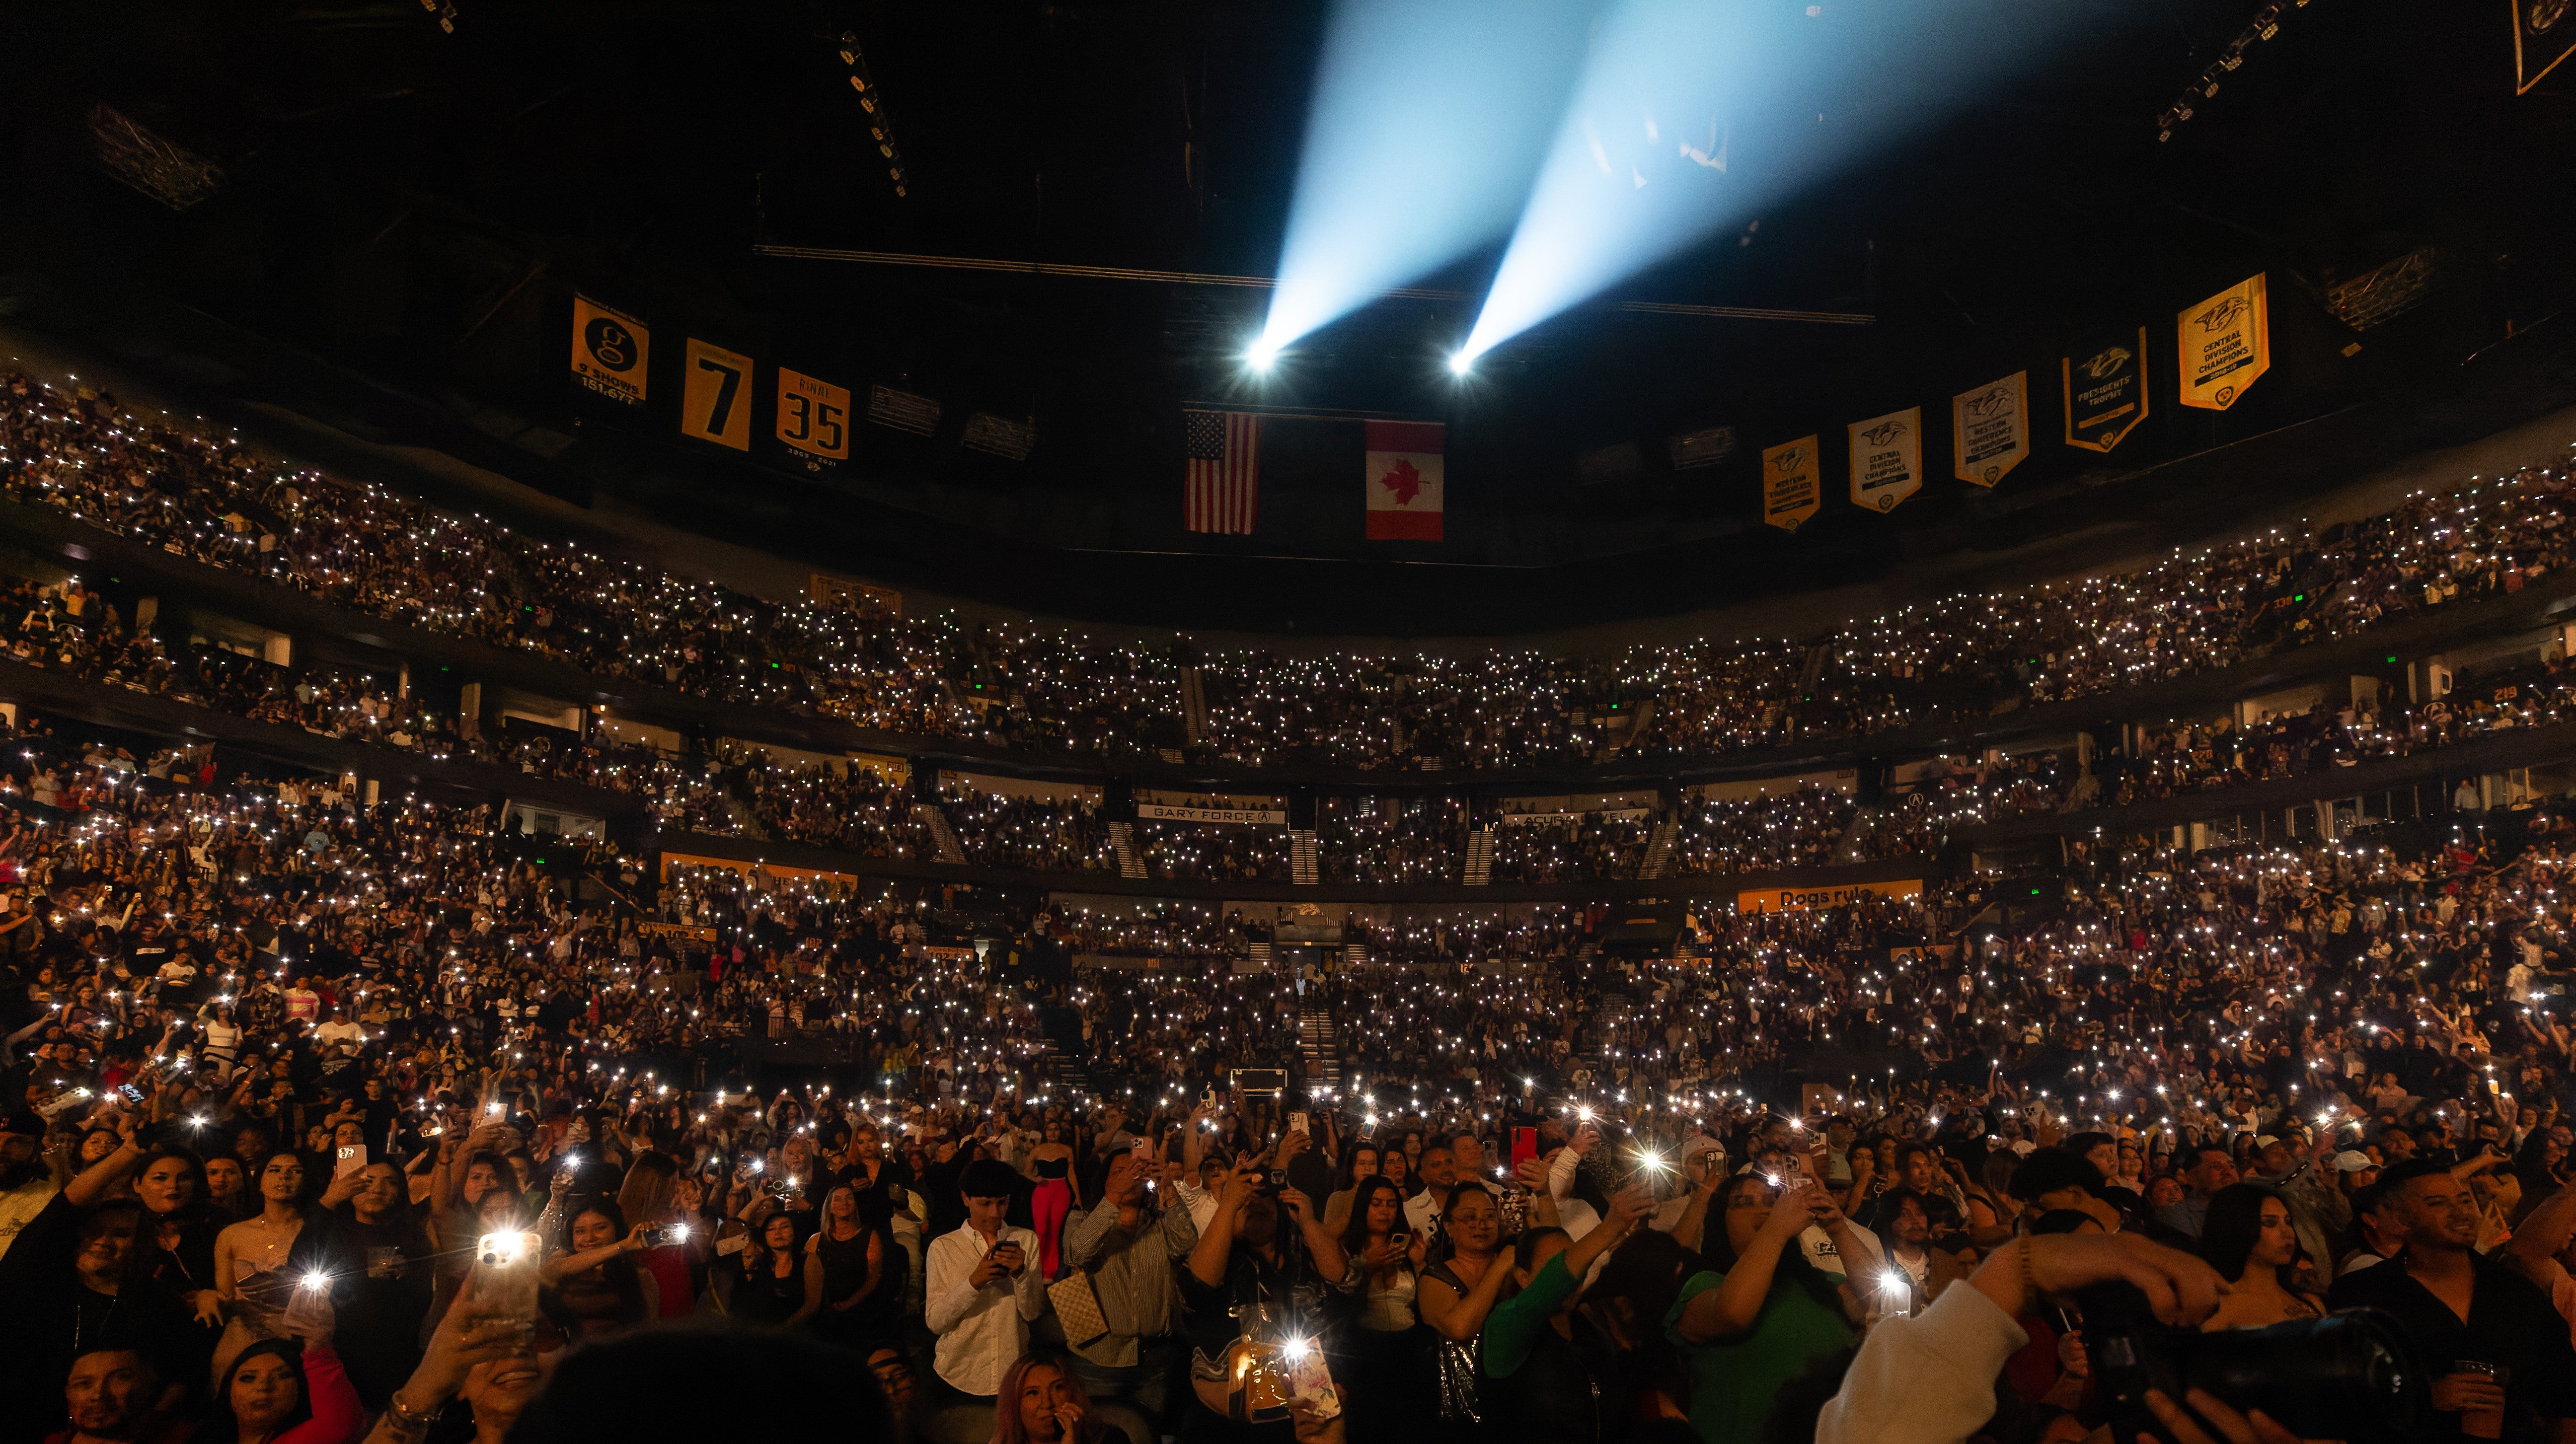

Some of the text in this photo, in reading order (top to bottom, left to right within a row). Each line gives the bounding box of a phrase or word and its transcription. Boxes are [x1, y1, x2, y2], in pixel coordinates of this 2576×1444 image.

[2204, 330, 2242, 353] CENTRAL
[2205, 338, 2242, 363] DIVISION
[2199, 346, 2249, 374] CHAMPIONS
[592, 368, 639, 394] SHOWS
[699, 358, 741, 437] 7
[784, 392, 843, 450] 35
[1865, 464, 1906, 480] CHAMPIONS
[2494, 685, 2518, 702] 219
[1154, 807, 1255, 821] GARY FORCE
[1781, 892, 1829, 907] Dogs
